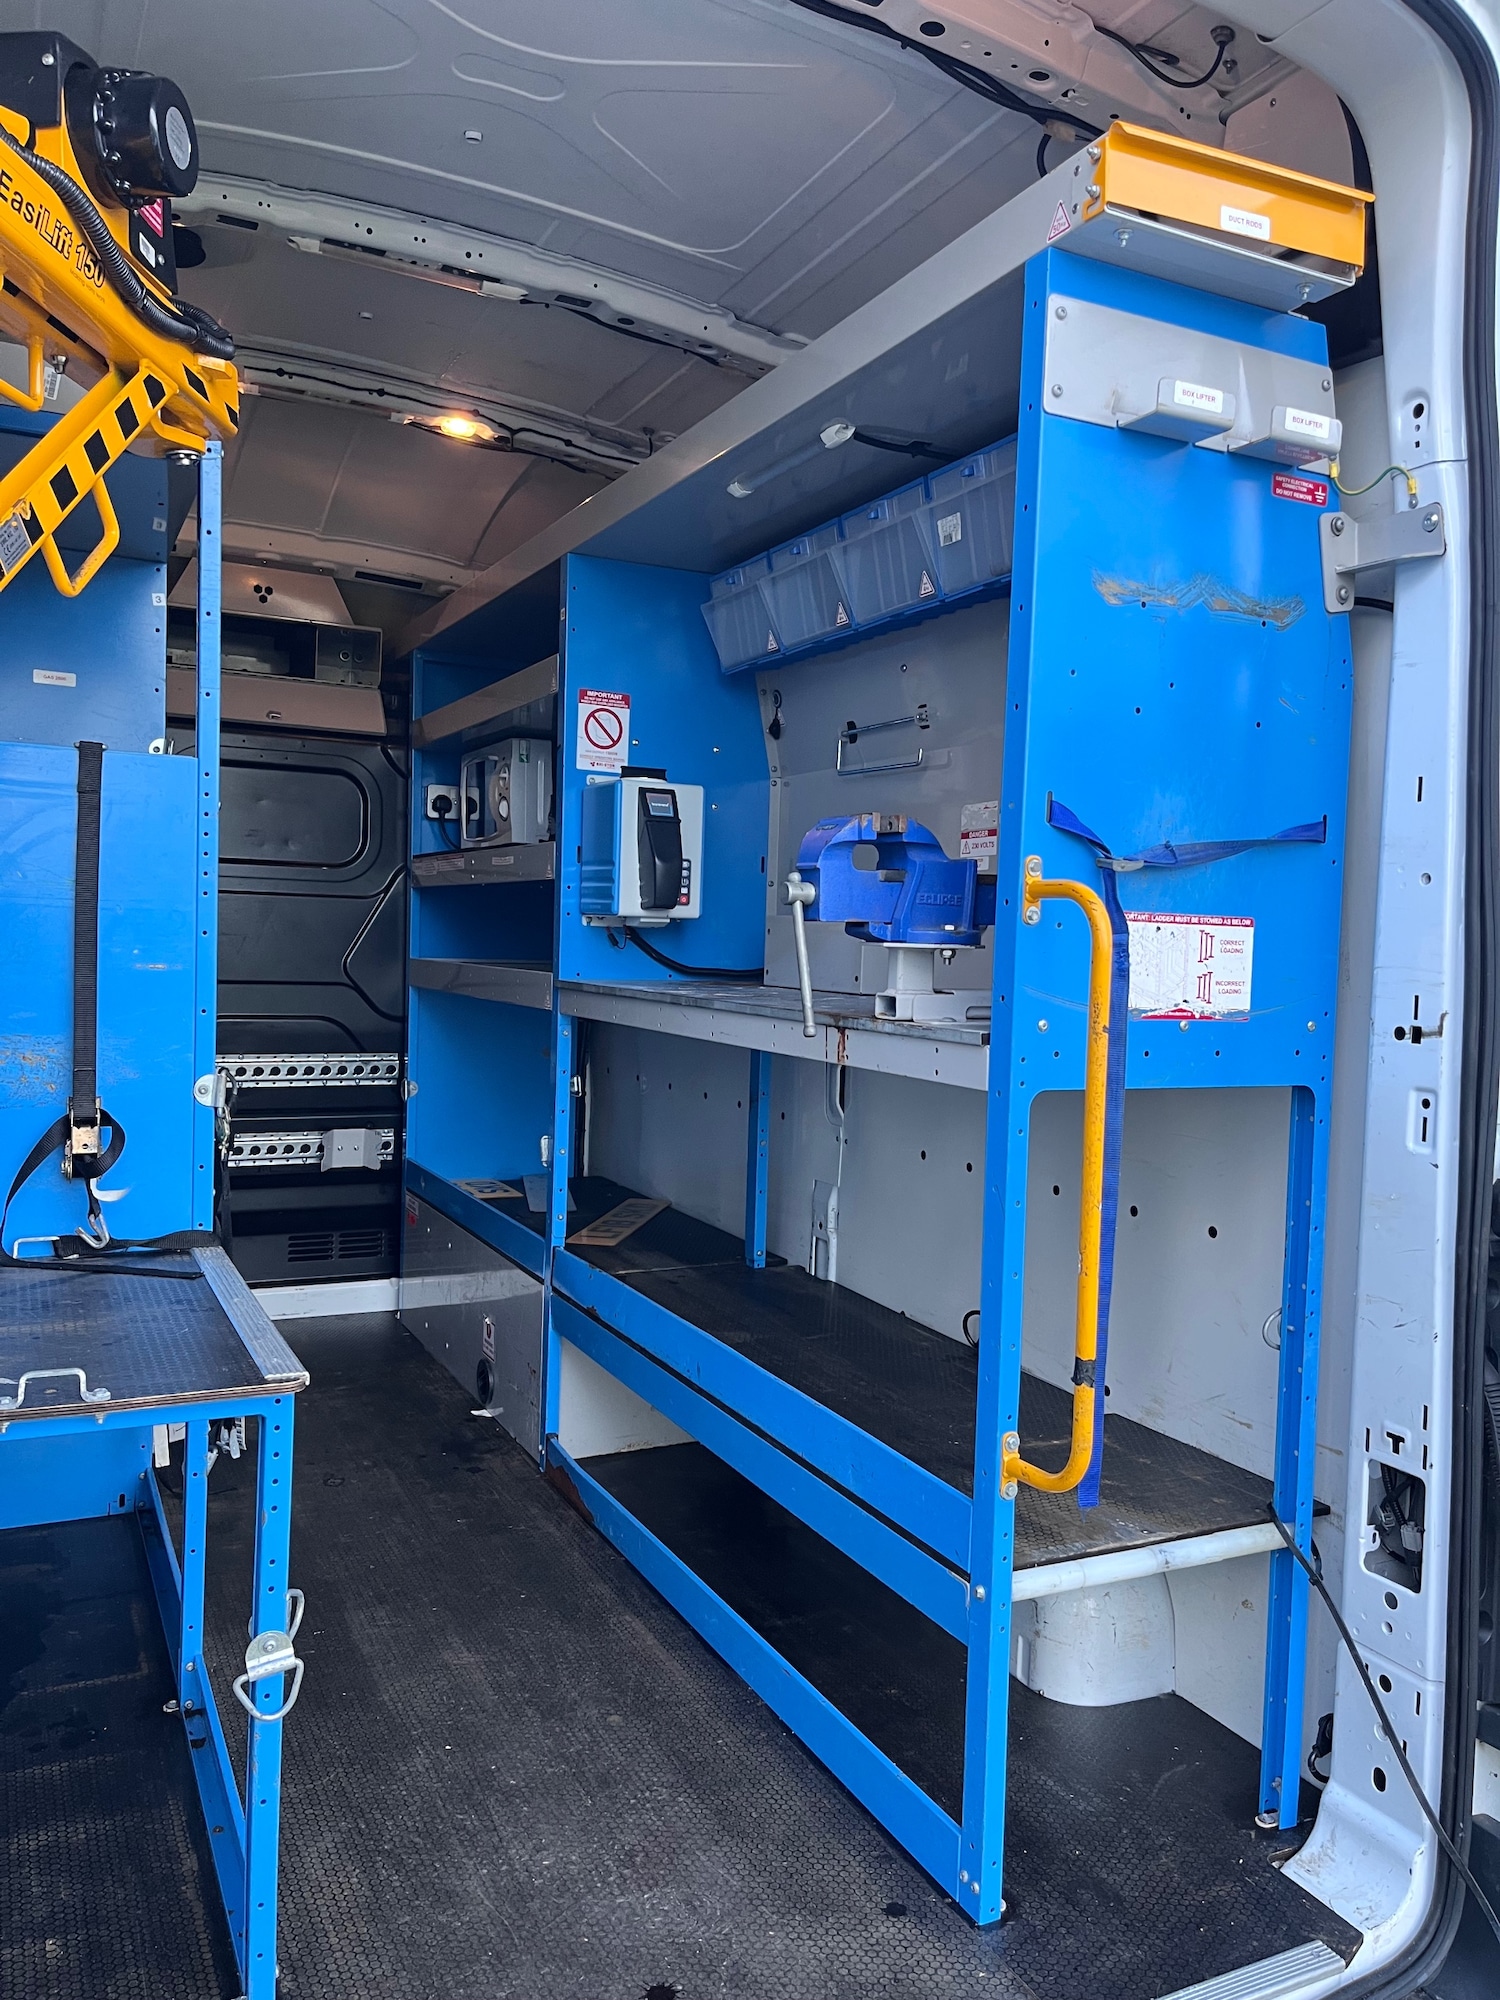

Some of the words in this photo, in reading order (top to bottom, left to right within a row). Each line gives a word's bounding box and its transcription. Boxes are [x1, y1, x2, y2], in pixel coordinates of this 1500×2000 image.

[0, 169, 73, 261] EasiLift
[75, 242, 105, 288] 150
[1228, 215, 1245, 226] DUCT
[1246, 218, 1263, 230] RODS
[1182, 388, 1195, 399] BOX
[1196, 391, 1216, 404] LIFTER
[1292, 415, 1304, 426] BOX
[1305, 418, 1323, 430] LIFTER
[1275, 475, 1291, 484] SAFETY
[1291, 478, 1315, 489] ELECTRICAL
[1281, 482, 1308, 493] CONNECTION
[1283, 489, 1293, 497] NOT
[1293, 491, 1313, 502] REMOVE
[155, 595, 162, 604] 3
[586, 690, 623, 701] IMPORTANT
[968, 830, 989, 839] DANGER
[980, 841, 995, 849] VOLTS
[917, 892, 962, 906] ECLIPSE
[1151, 914, 1175, 923] LADDER
[1191, 916, 1200, 924] BE
[1200, 917, 1223, 925] STOWED
[1232, 918, 1252, 926] BELOW
[1219, 939, 1245, 947] CORRECT
